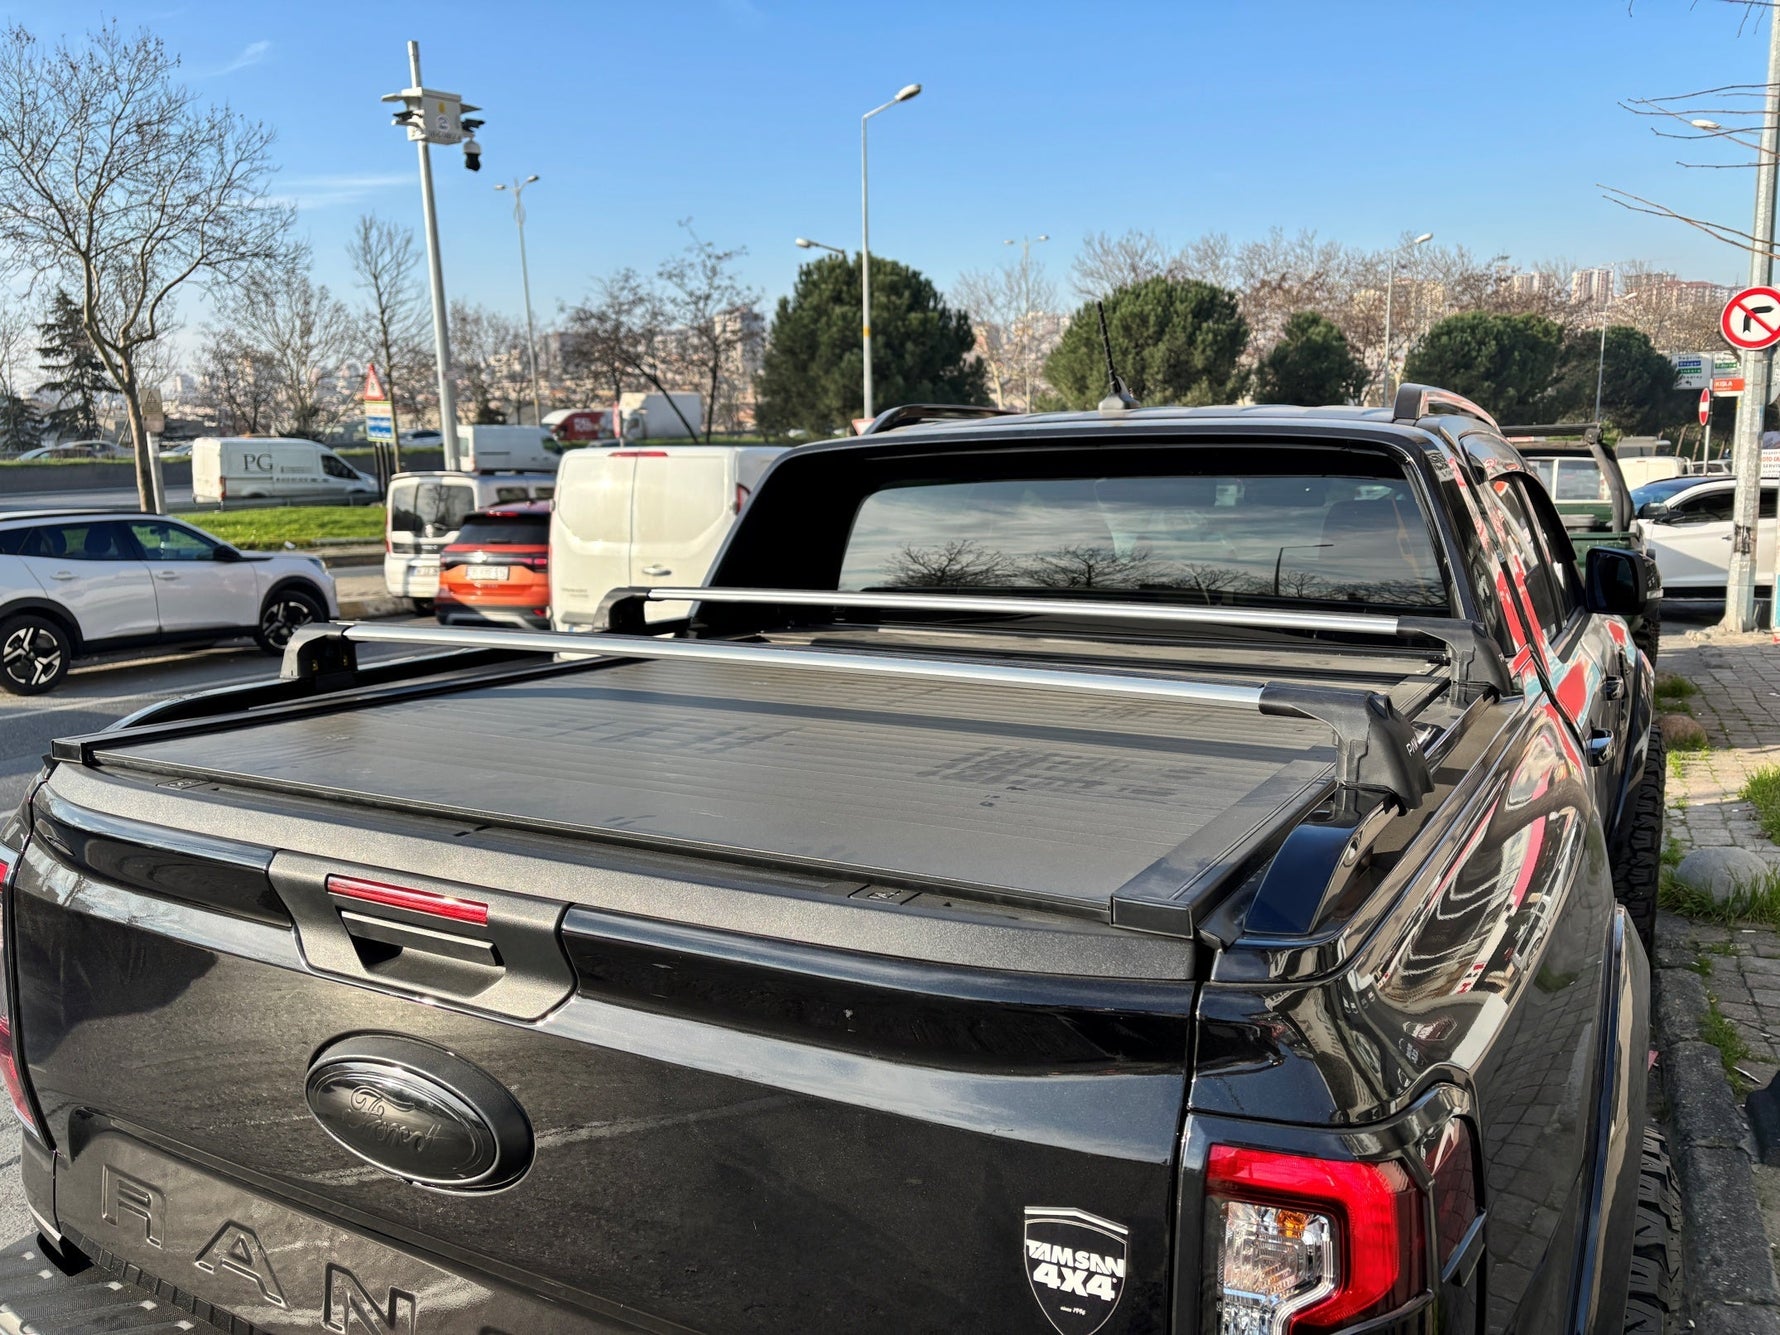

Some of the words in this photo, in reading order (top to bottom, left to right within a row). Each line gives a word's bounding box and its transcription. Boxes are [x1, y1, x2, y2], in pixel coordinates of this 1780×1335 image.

[243, 453, 273, 472] PG
[349, 1085, 441, 1153] Ford
[102, 1164, 512, 1335] RAN
[1026, 1239, 1125, 1278] TAMSAN
